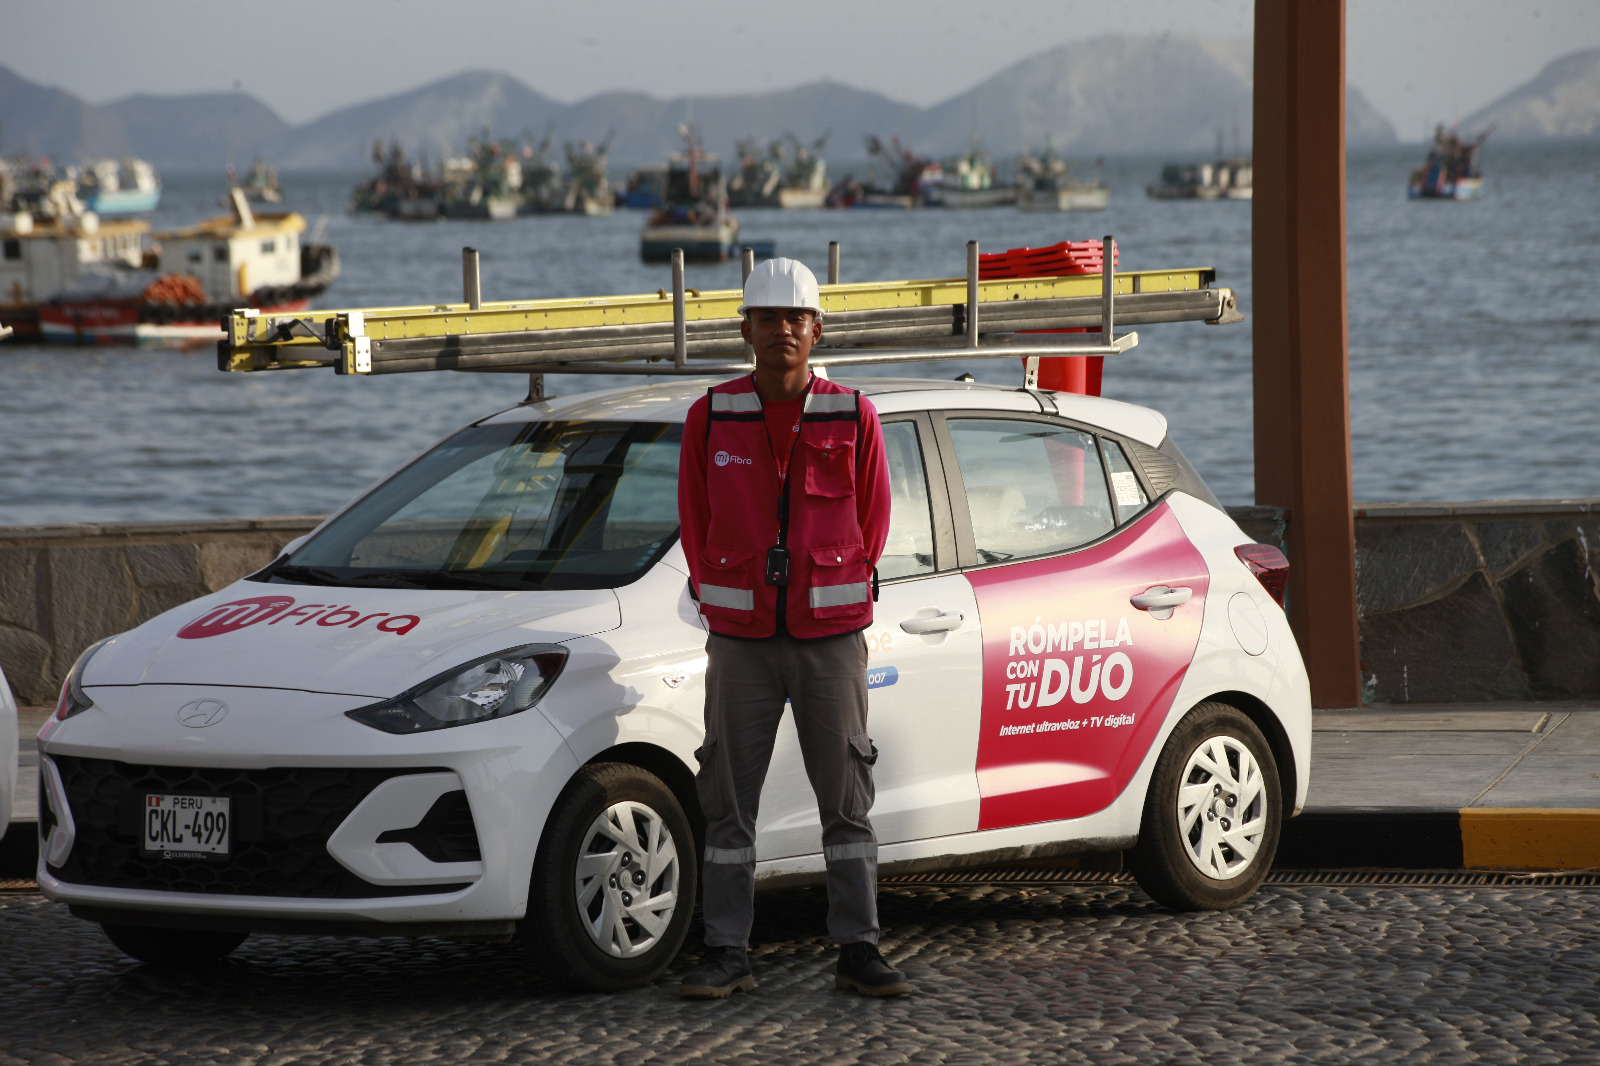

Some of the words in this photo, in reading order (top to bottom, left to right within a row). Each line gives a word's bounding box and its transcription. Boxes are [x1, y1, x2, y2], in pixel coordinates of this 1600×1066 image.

[730, 455, 752, 465] Fibra
[268, 604, 420, 635] Fibra
[1009, 616, 1133, 656] RÓMPELA
[868, 672, 887, 685] 007
[1005, 682, 1036, 710] TU
[1036, 651, 1133, 707] DÚO
[1006, 659, 1040, 679] CON
[999, 724, 1035, 736] Internet
[1036, 719, 1080, 733] ultraveloz
[1082, 719, 1088, 728] +
[1090, 716, 1104, 728] TV
[1104, 713, 1135, 728] digital
[173, 797, 203, 809] PERU
[148, 809, 227, 845] CKL-499
